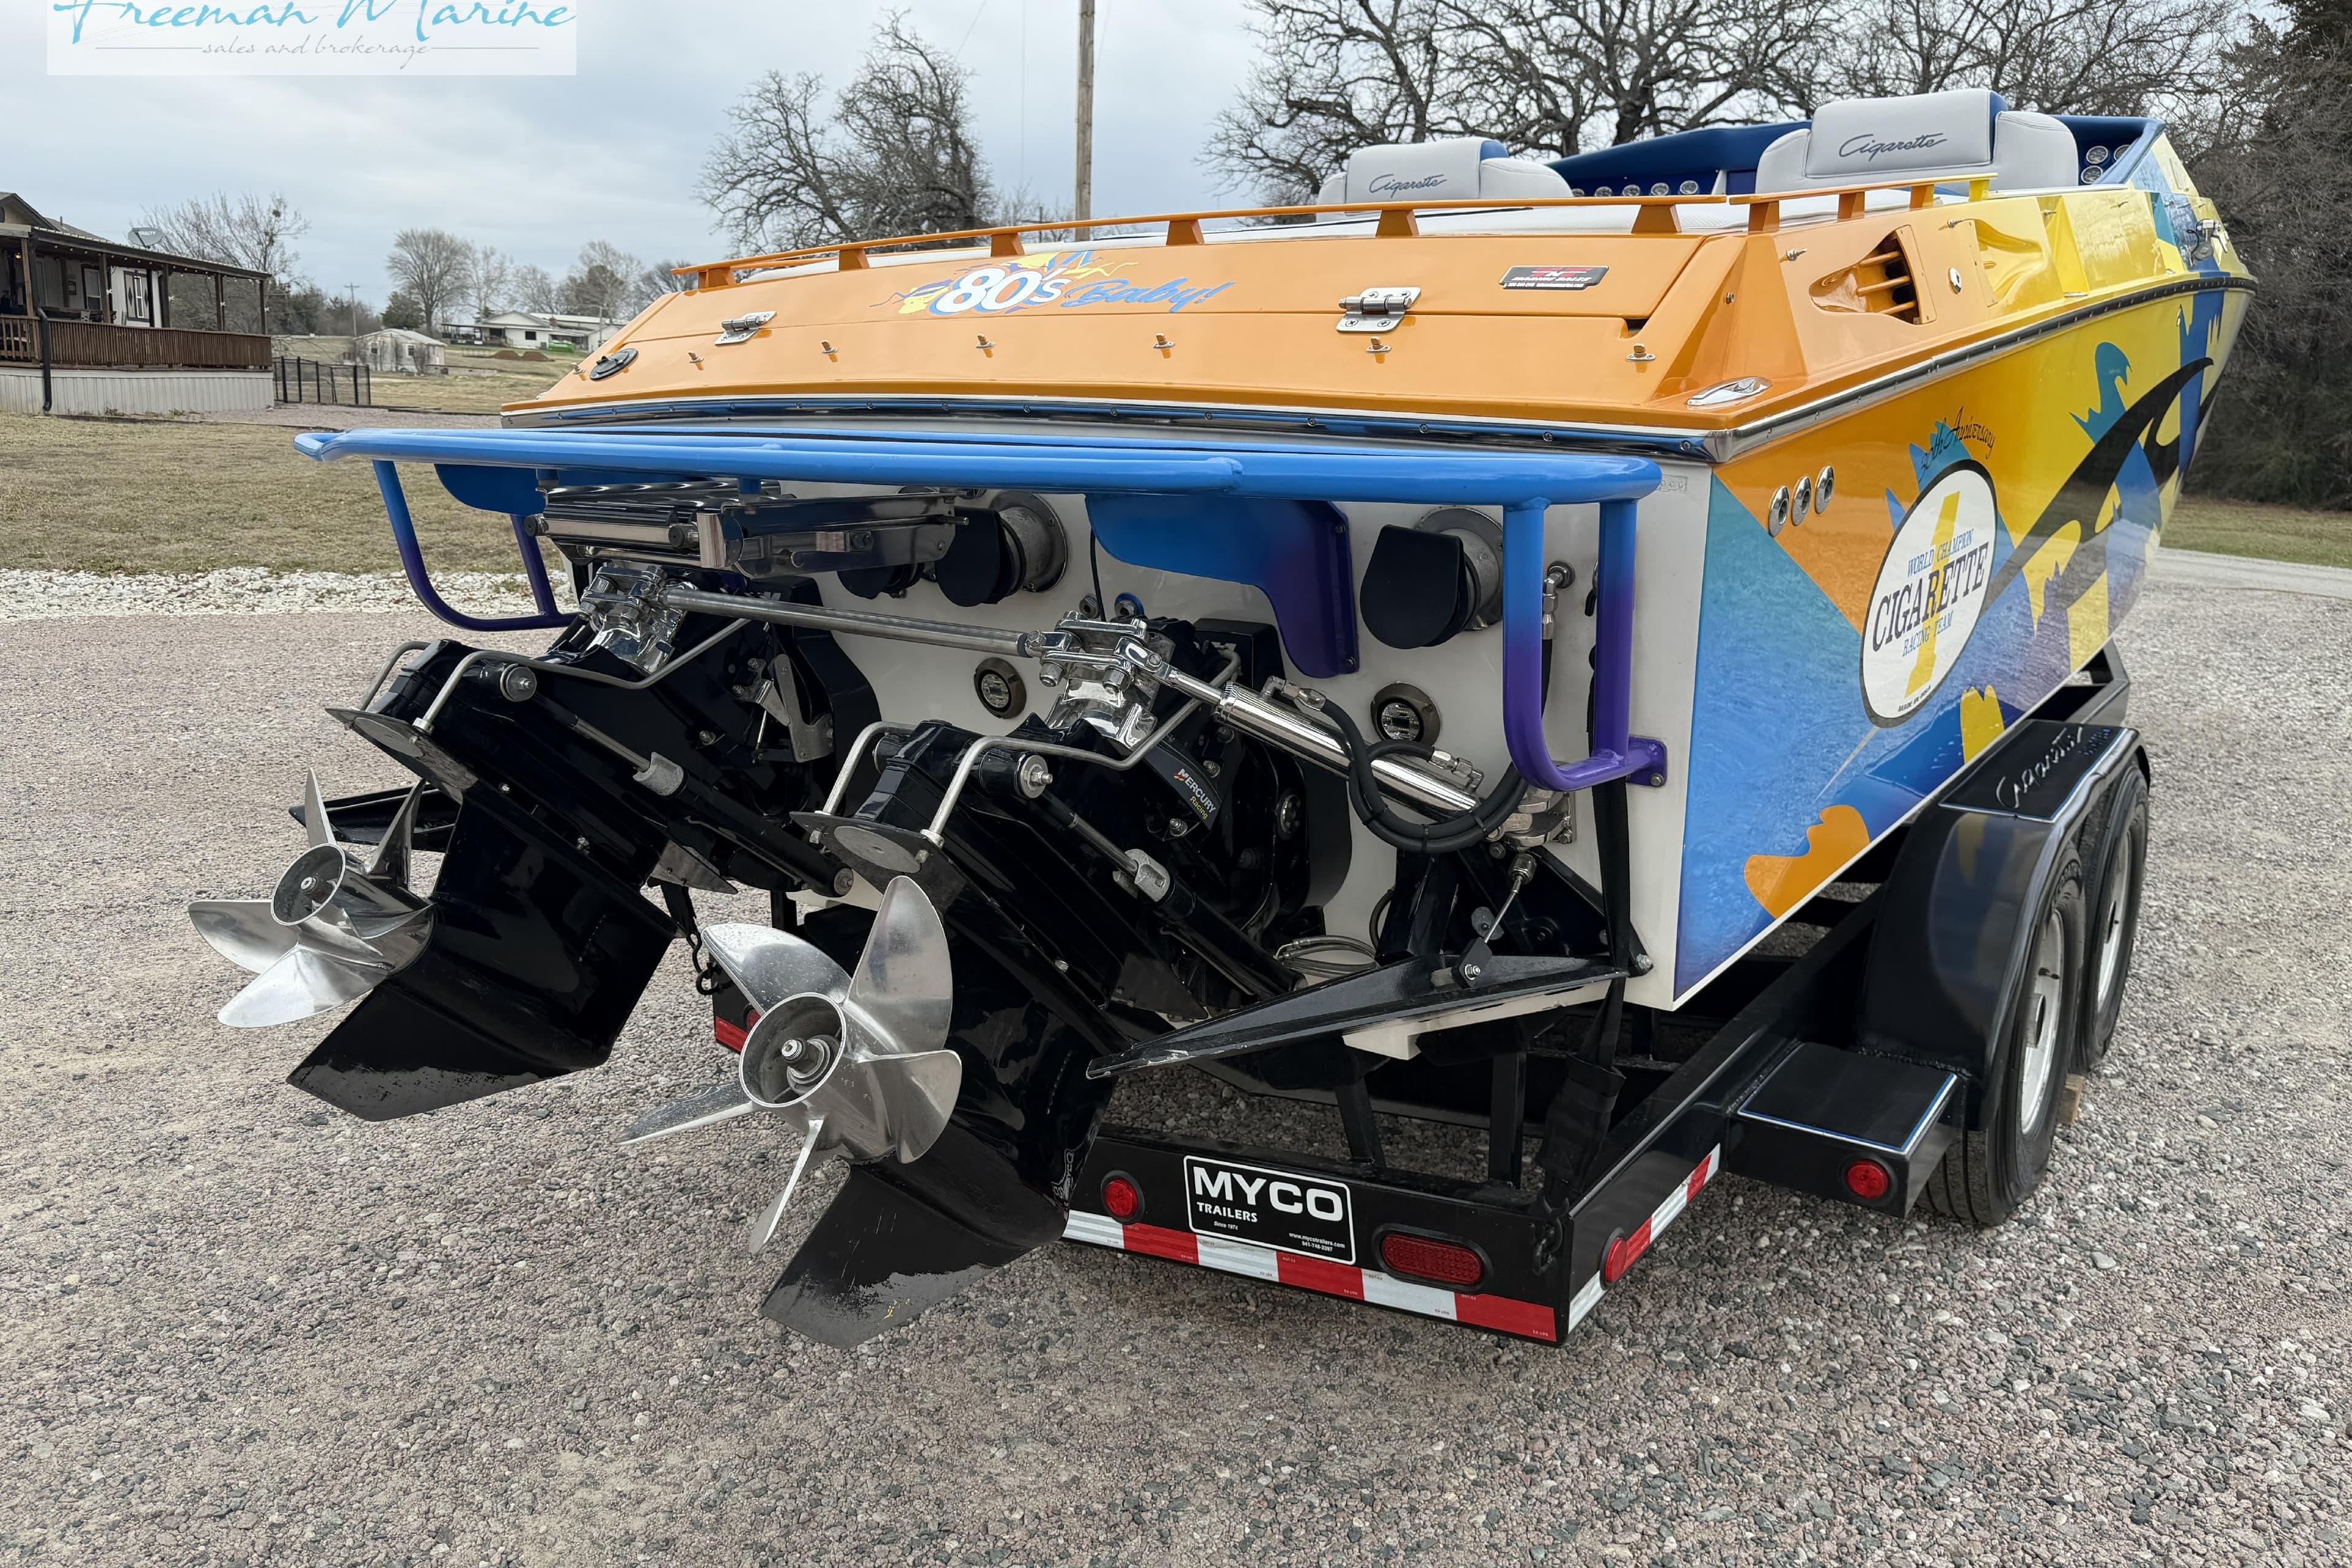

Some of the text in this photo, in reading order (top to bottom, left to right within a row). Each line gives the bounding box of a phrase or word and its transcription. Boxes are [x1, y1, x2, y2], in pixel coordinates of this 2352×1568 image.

[1839, 132, 1947, 162] Cigarette
[1369, 174, 1447, 198] Cigarette
[929, 266, 1236, 315] 80's Baby!
[1908, 528, 1974, 578] WORLD CHAMPION
[1872, 541, 1989, 652] CIGARETTE
[1902, 611, 1953, 657] RACING TEAM
[1177, 768, 1216, 813] MERCURY
[1190, 796, 1208, 820] Racing
[1193, 1166, 1344, 1222] MYCO
[1196, 1202, 1258, 1223] TRAILERS
